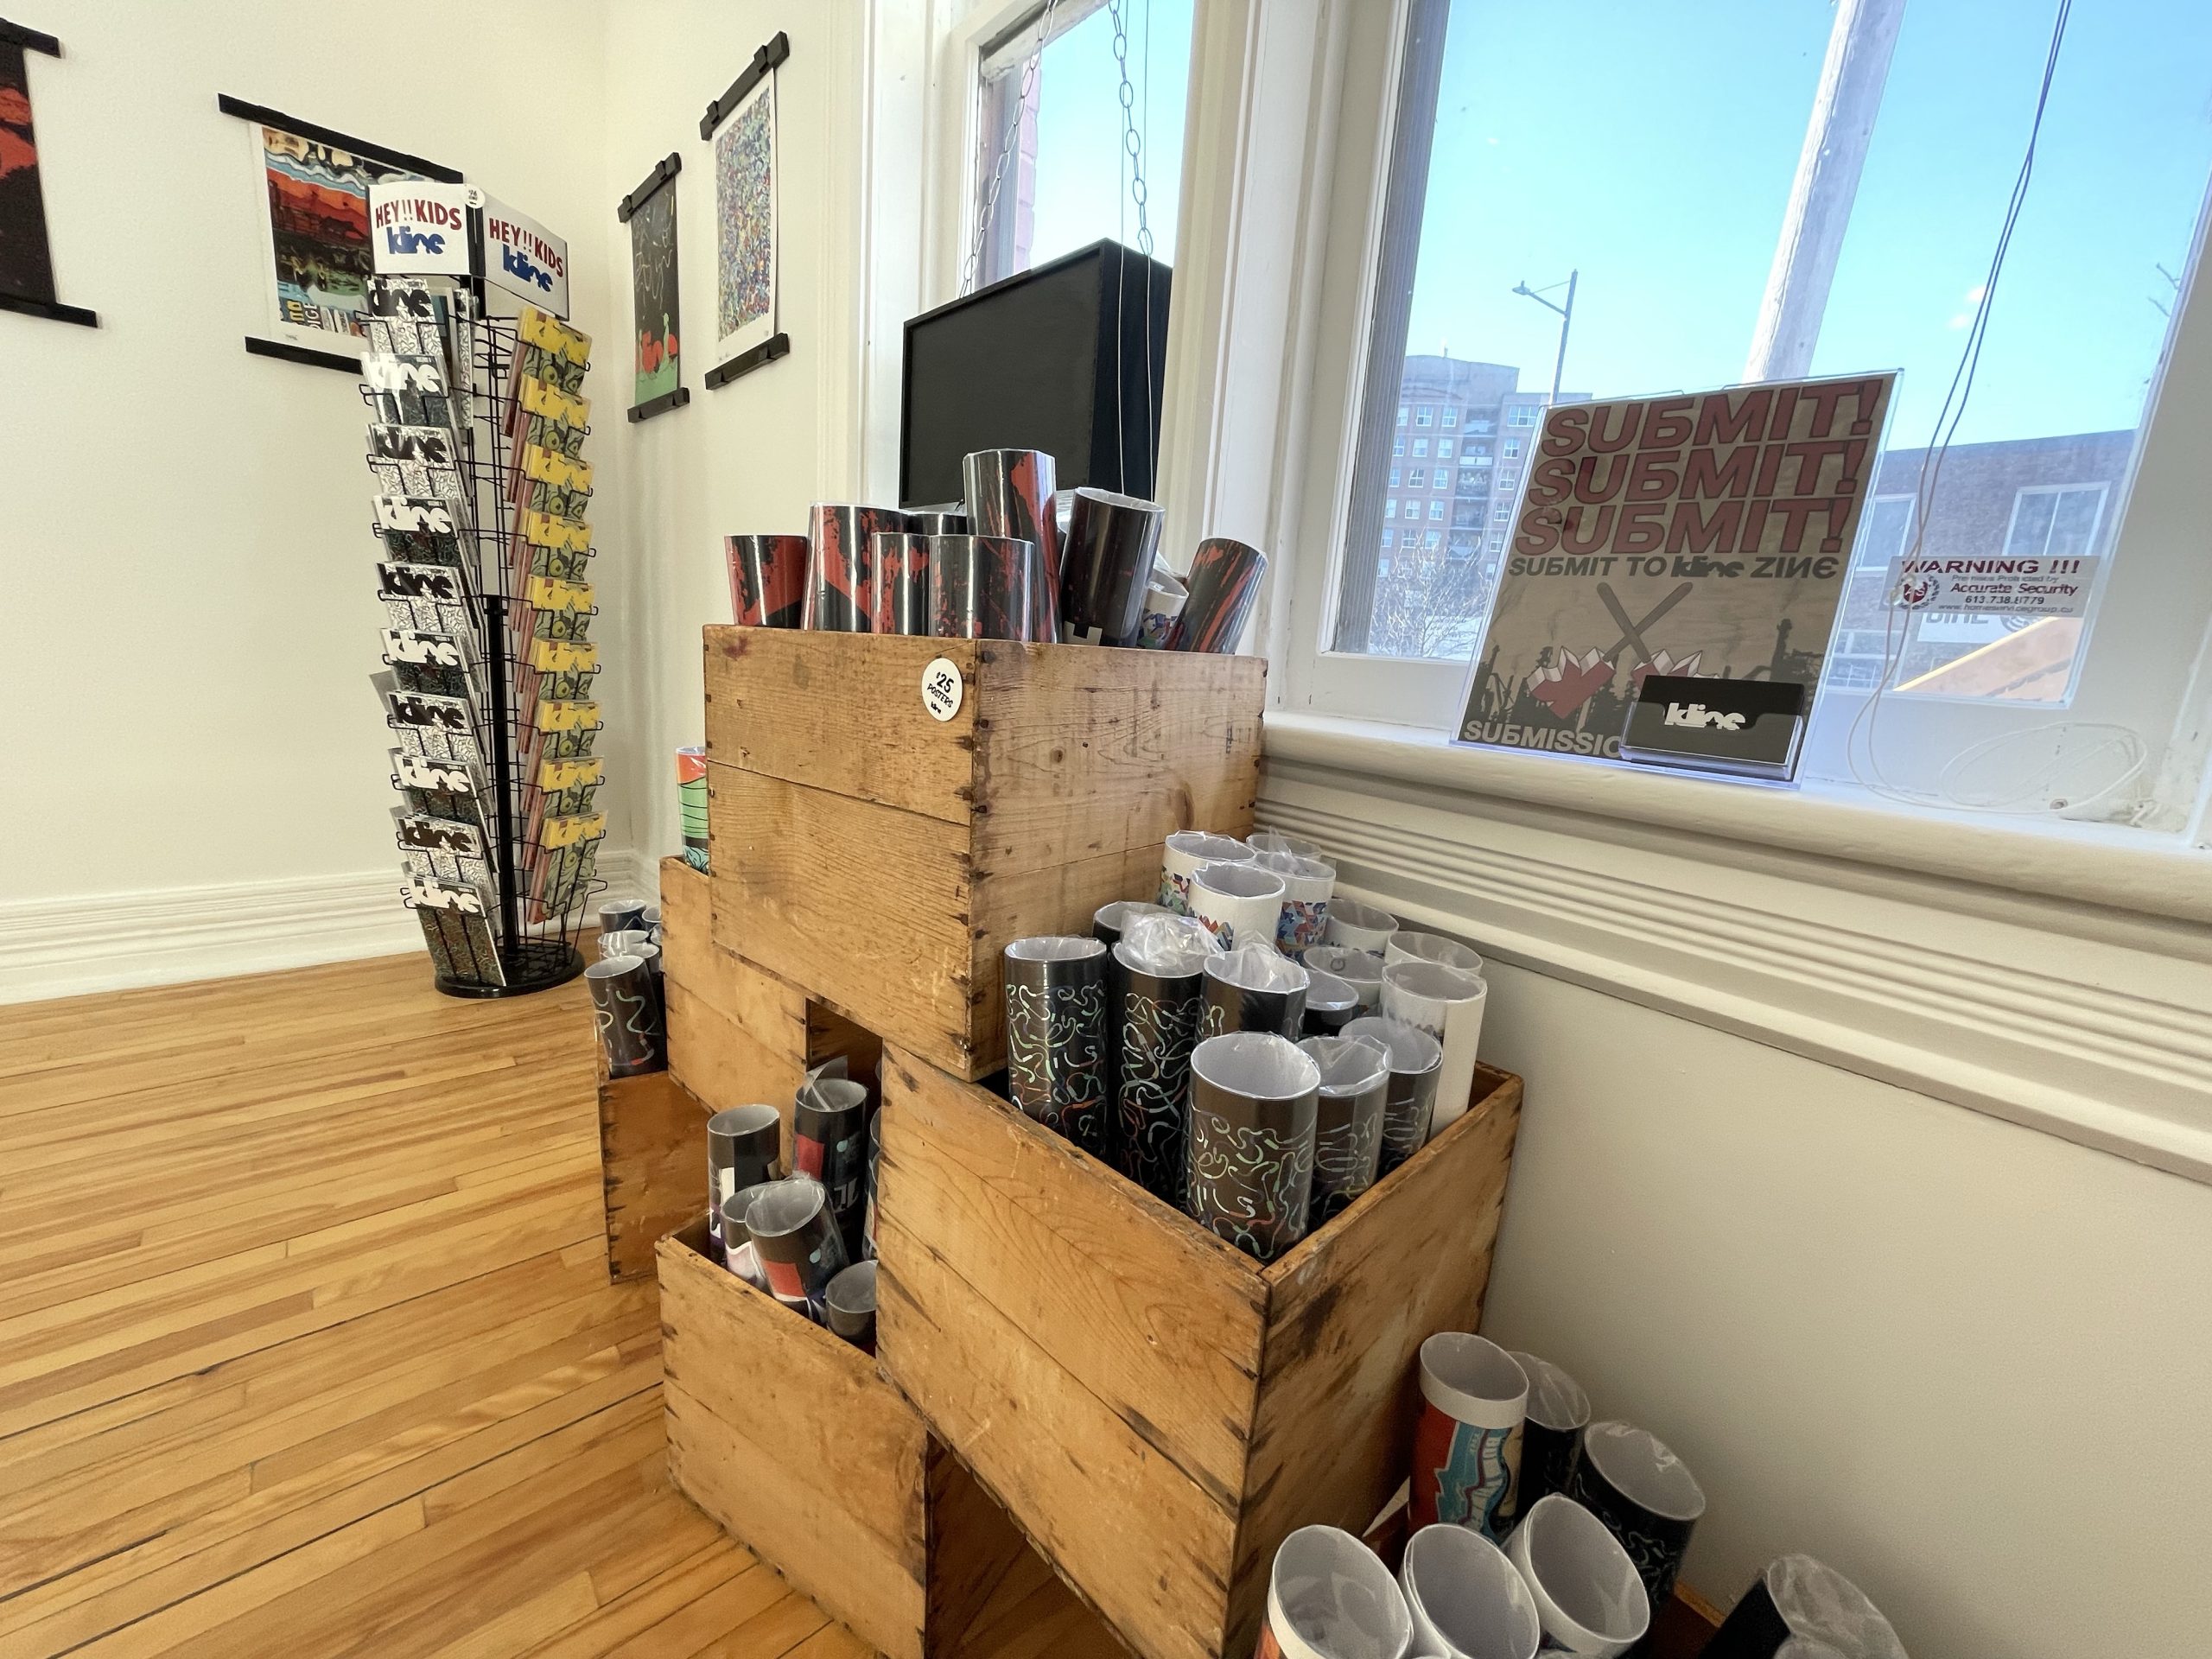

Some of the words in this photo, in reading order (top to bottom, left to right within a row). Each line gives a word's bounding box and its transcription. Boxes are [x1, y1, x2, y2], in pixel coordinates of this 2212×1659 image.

[1627, 556, 1668, 577] TO
[1901, 560, 2040, 574] WARNING
[2018, 583, 2079, 596] Security
[927, 683, 953, 708] POSTERS
